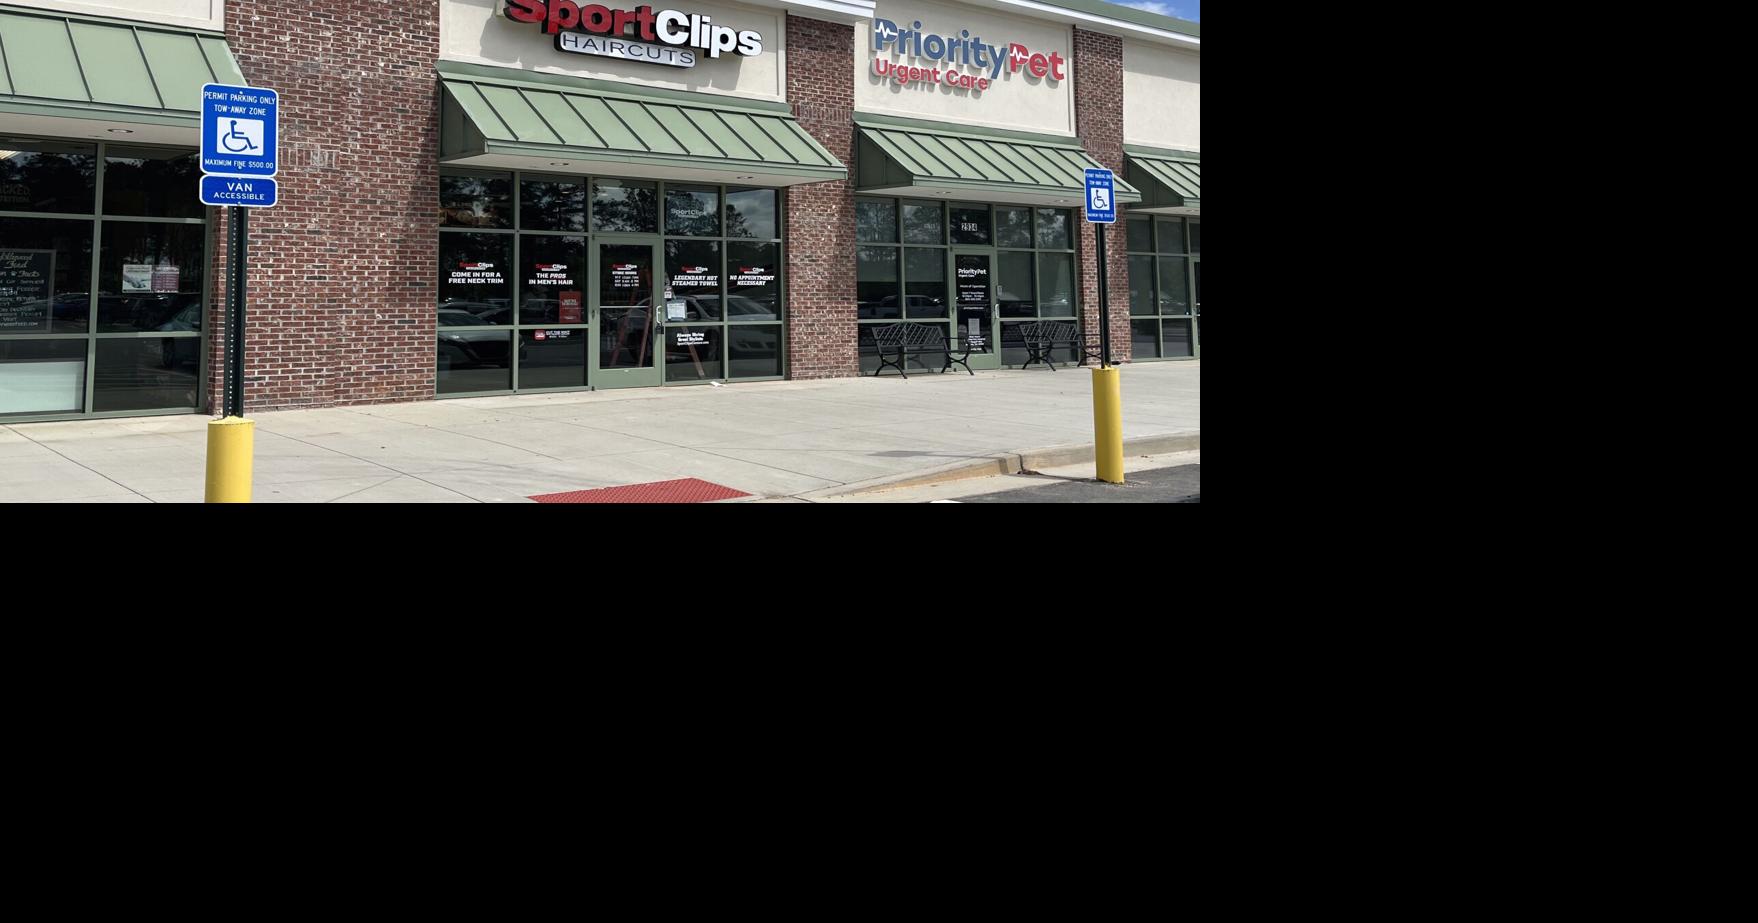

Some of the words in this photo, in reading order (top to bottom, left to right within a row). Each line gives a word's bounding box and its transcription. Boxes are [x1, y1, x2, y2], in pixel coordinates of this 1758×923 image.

[562, 33, 694, 64] HAIRCUTS
[875, 58, 941, 83] Urgent
[945, 69, 988, 91] Care
[204, 91, 228, 100] PERMIT
[230, 94, 258, 103] PARKING
[259, 96, 276, 104] ONLY
[214, 104, 247, 114] TOW-AWAY
[248, 107, 267, 116] ZONE
[204, 159, 232, 167] MAXIMUM
[227, 182, 253, 192] VAN
[213, 192, 265, 200] ACCESSIBLE
